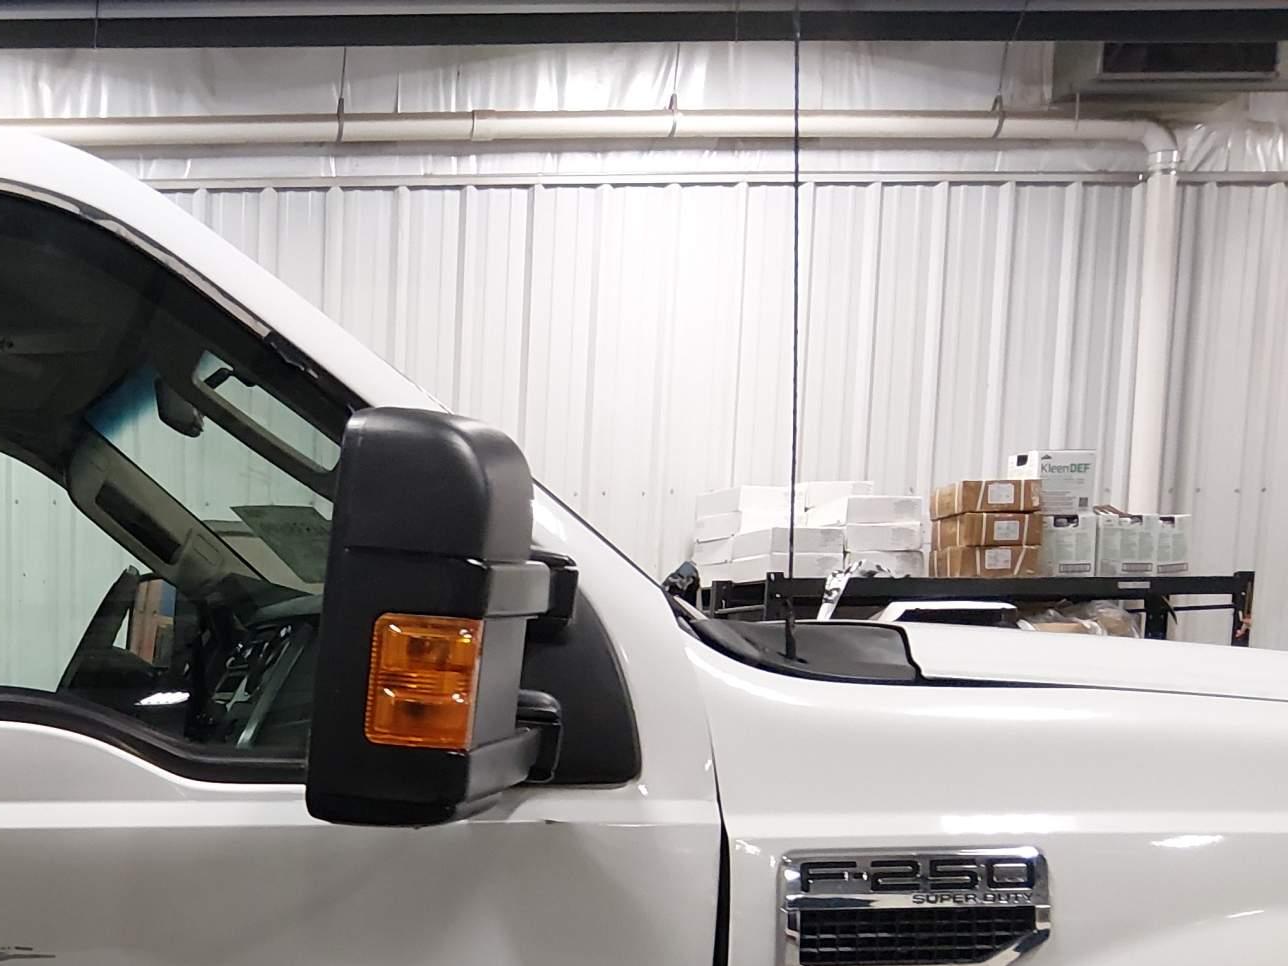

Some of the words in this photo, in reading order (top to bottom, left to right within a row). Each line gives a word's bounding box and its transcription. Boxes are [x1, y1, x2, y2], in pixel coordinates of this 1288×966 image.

[1040, 463, 1092, 474] KleenDEF
[800, 858, 1036, 893] F-250
[912, 892, 978, 905] SUPER
[983, 892, 1033, 905] DUTY
